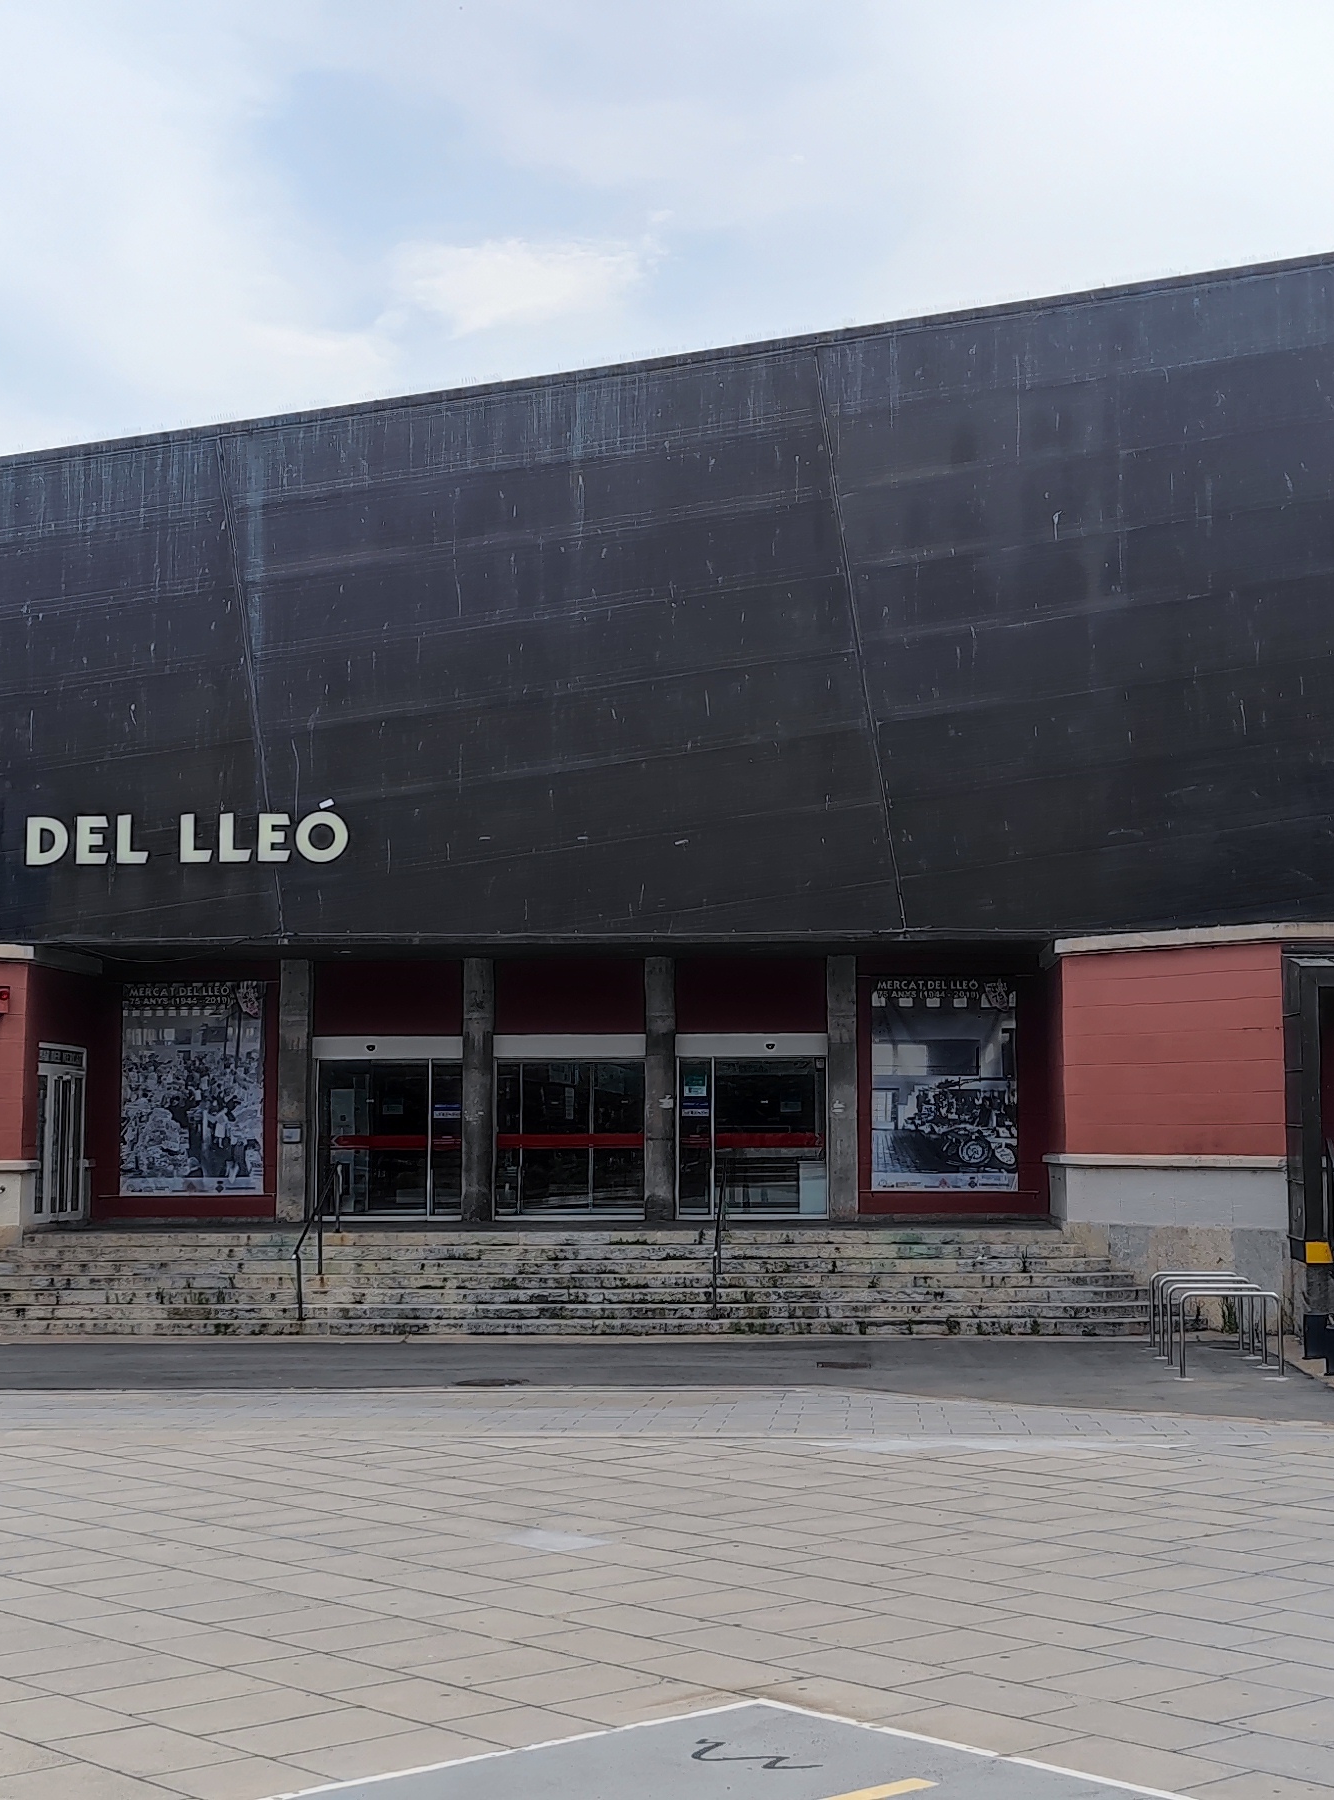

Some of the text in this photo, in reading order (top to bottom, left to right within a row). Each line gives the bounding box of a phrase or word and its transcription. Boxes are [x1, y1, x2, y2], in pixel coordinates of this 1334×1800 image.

[25, 813, 149, 866] DEL
[178, 798, 349, 864] LLEÓ
[129, 984, 230, 996] MERCAT DEL LLEÓ
[877, 978, 978, 990] MERCAT DEL LLEÓ
[891, 990, 917, 998] ANYS
[143, 997, 167, 1005] ANYS
